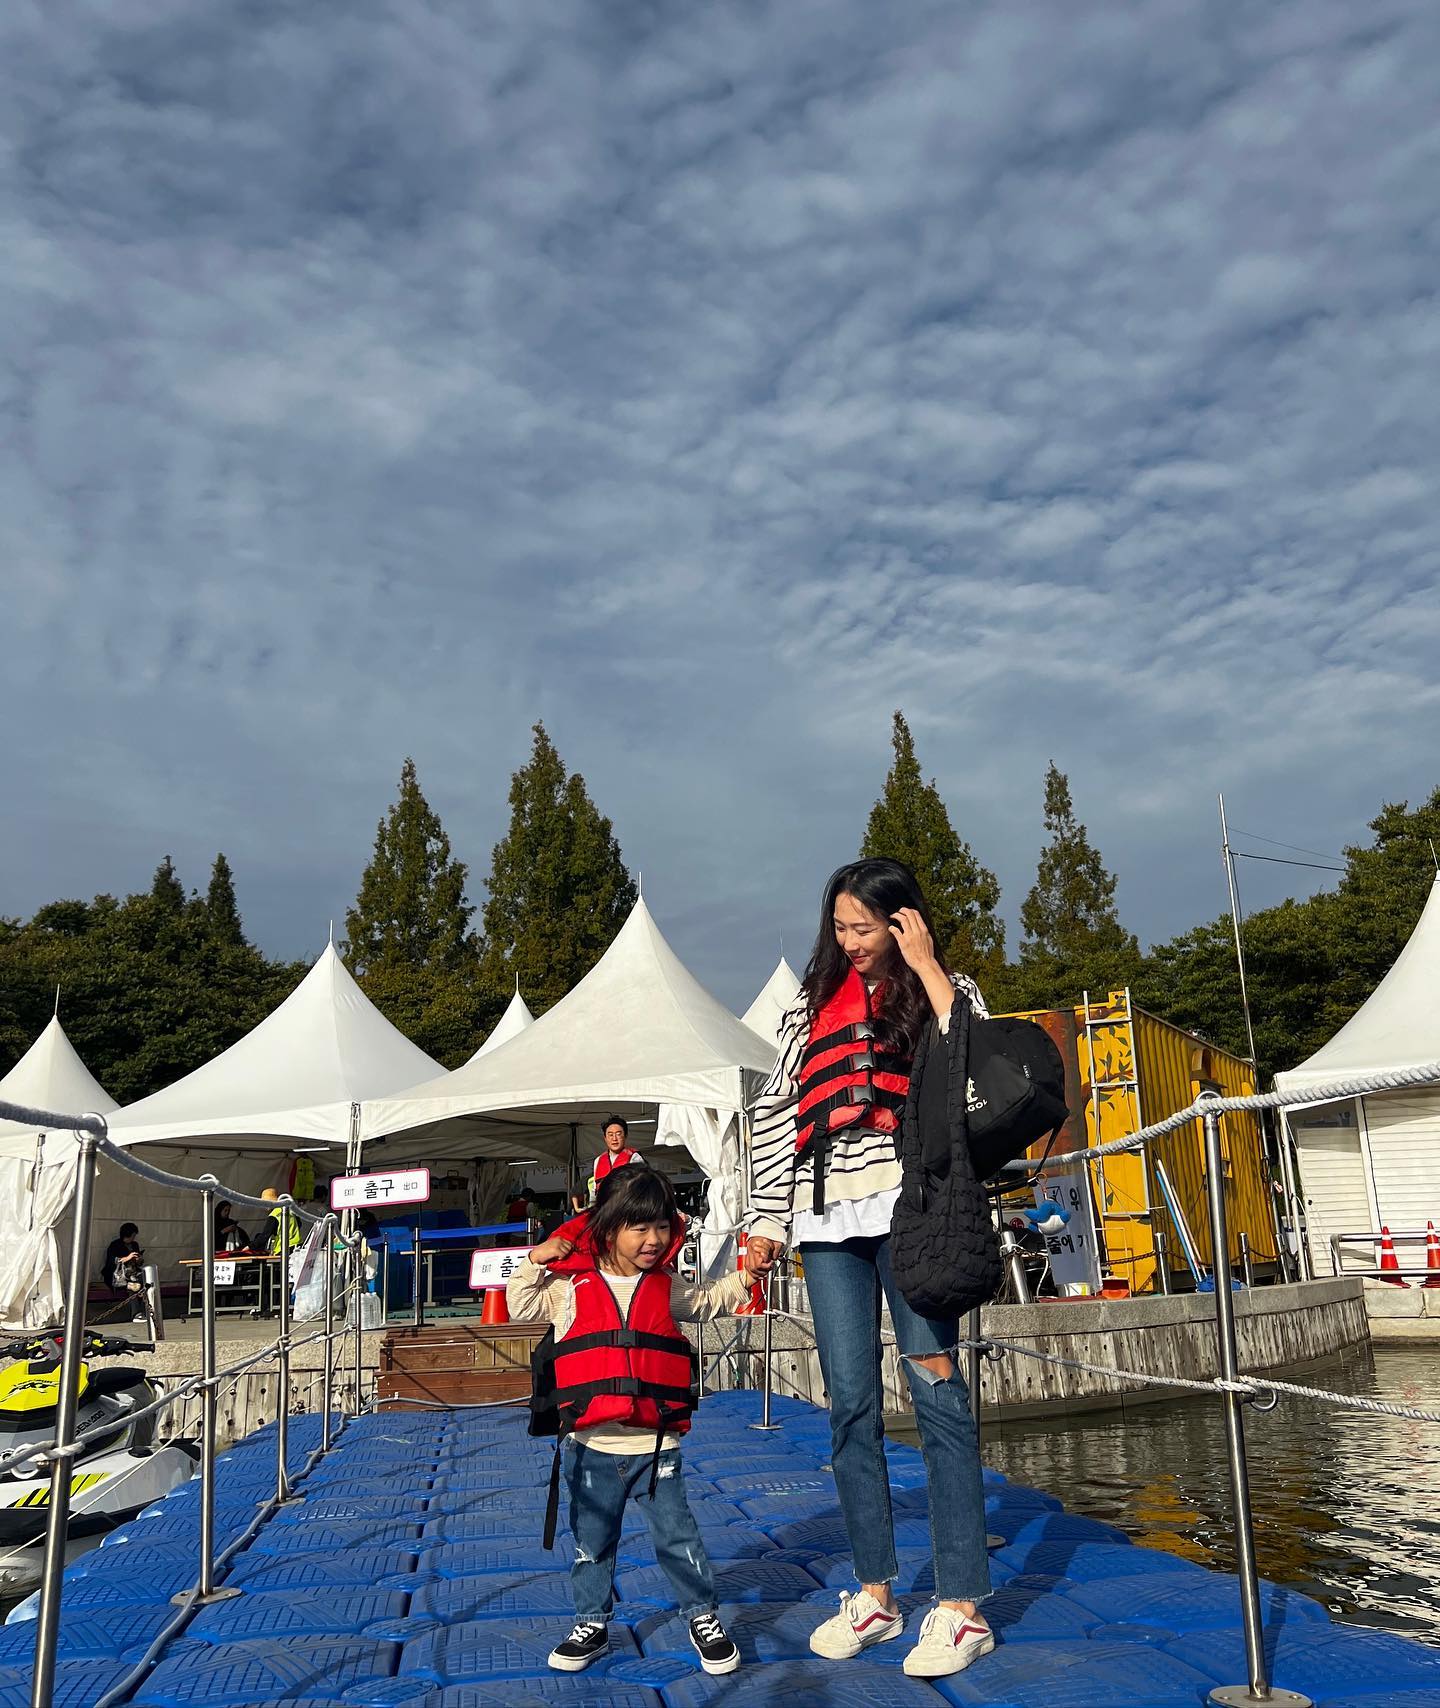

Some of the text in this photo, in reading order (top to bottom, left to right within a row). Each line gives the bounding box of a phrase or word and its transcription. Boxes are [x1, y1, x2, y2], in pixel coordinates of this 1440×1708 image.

[364, 1179, 395, 1199] 출구
[403, 1181, 418, 1191] 出口
[1047, 1234, 1076, 1255] 줄에
